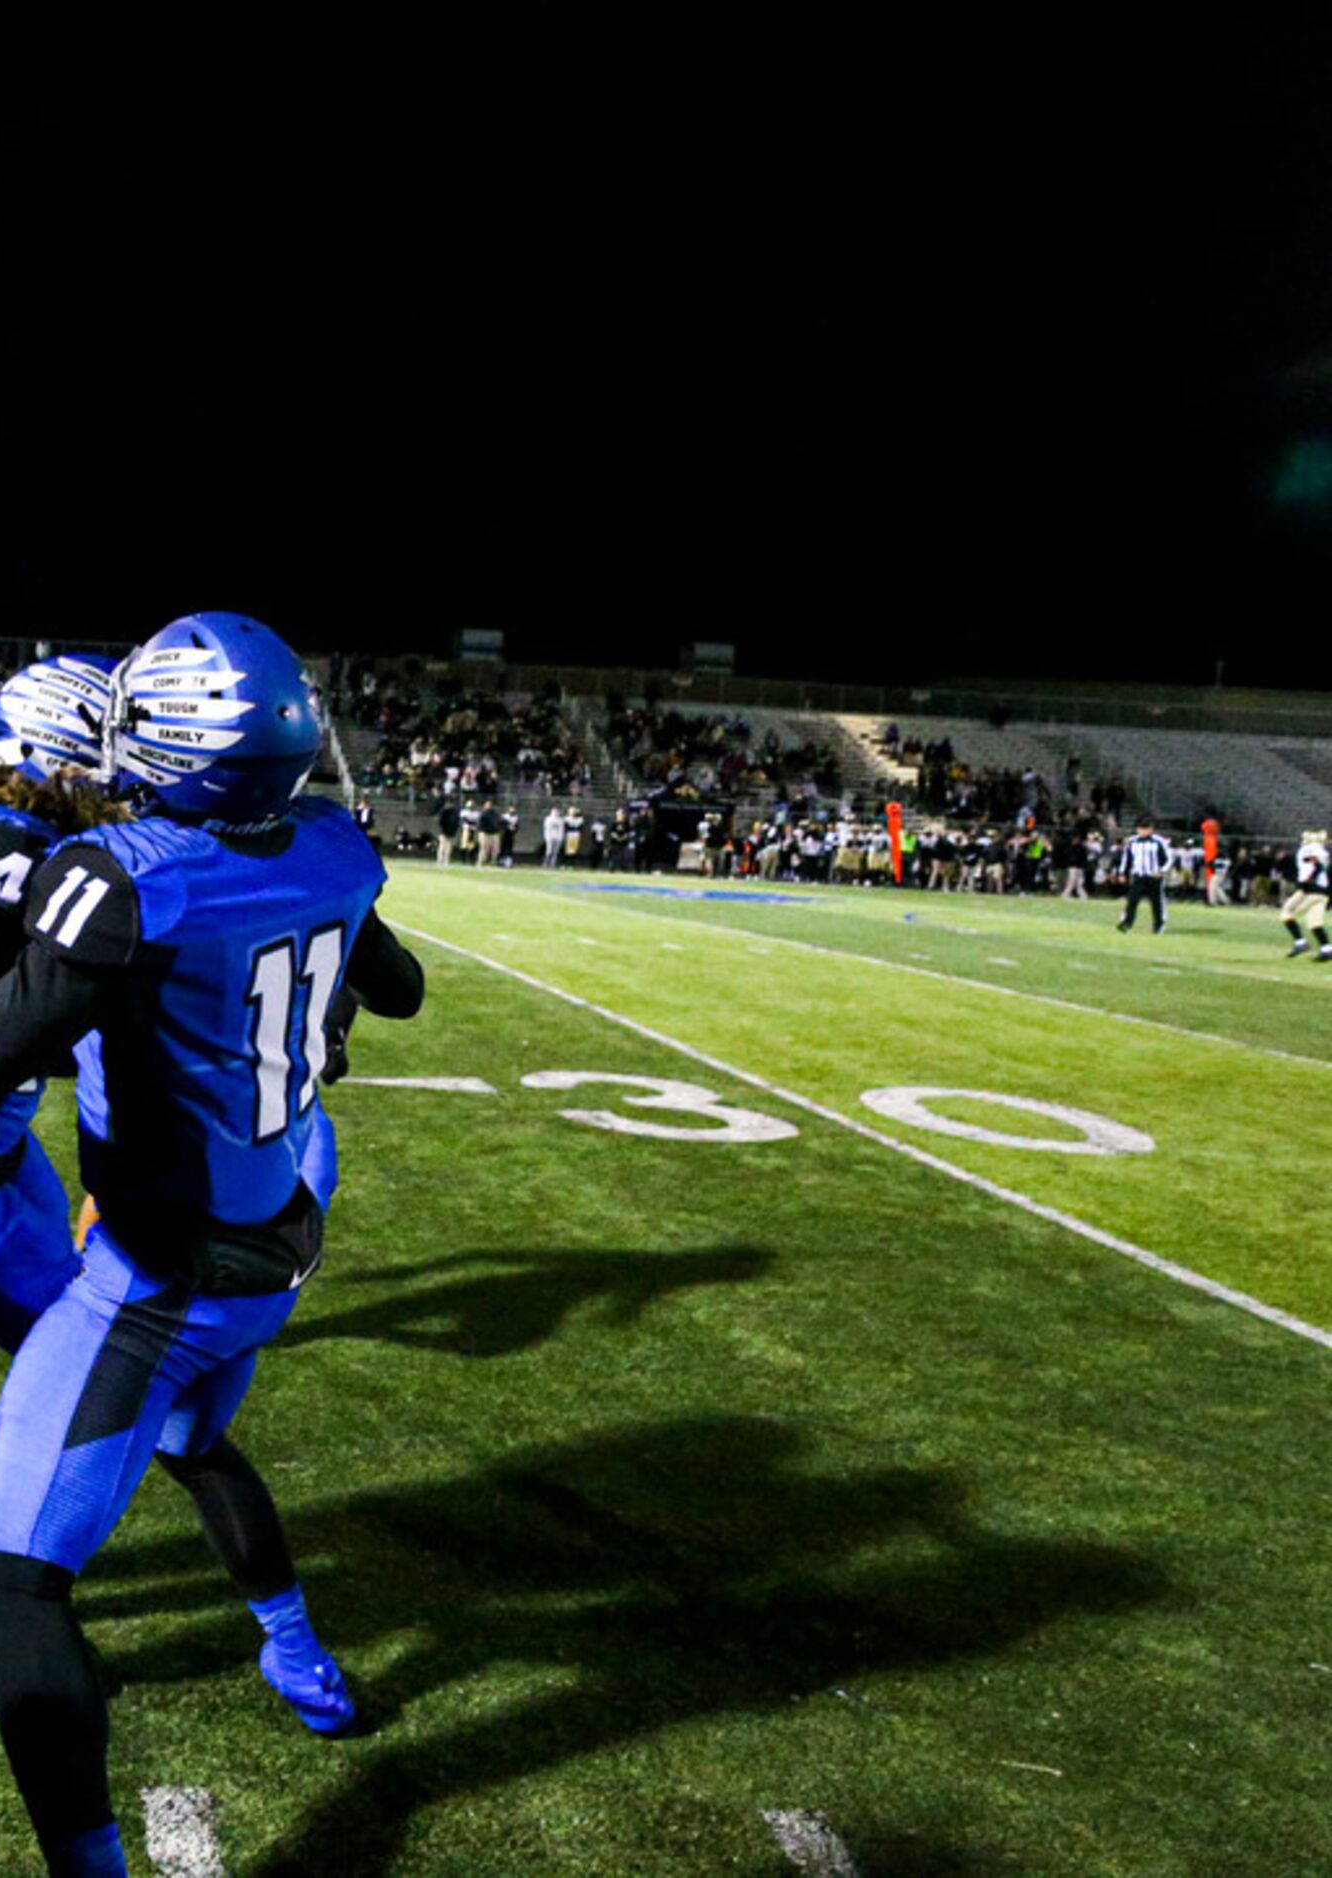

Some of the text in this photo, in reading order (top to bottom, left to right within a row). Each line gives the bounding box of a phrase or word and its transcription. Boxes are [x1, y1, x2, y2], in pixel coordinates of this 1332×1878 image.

[153, 676, 207, 689] COMPTE
[158, 702, 199, 714] TOUGH
[158, 728, 205, 743] FAMILY
[34, 865, 111, 948] 11
[247, 923, 344, 1140] 11
